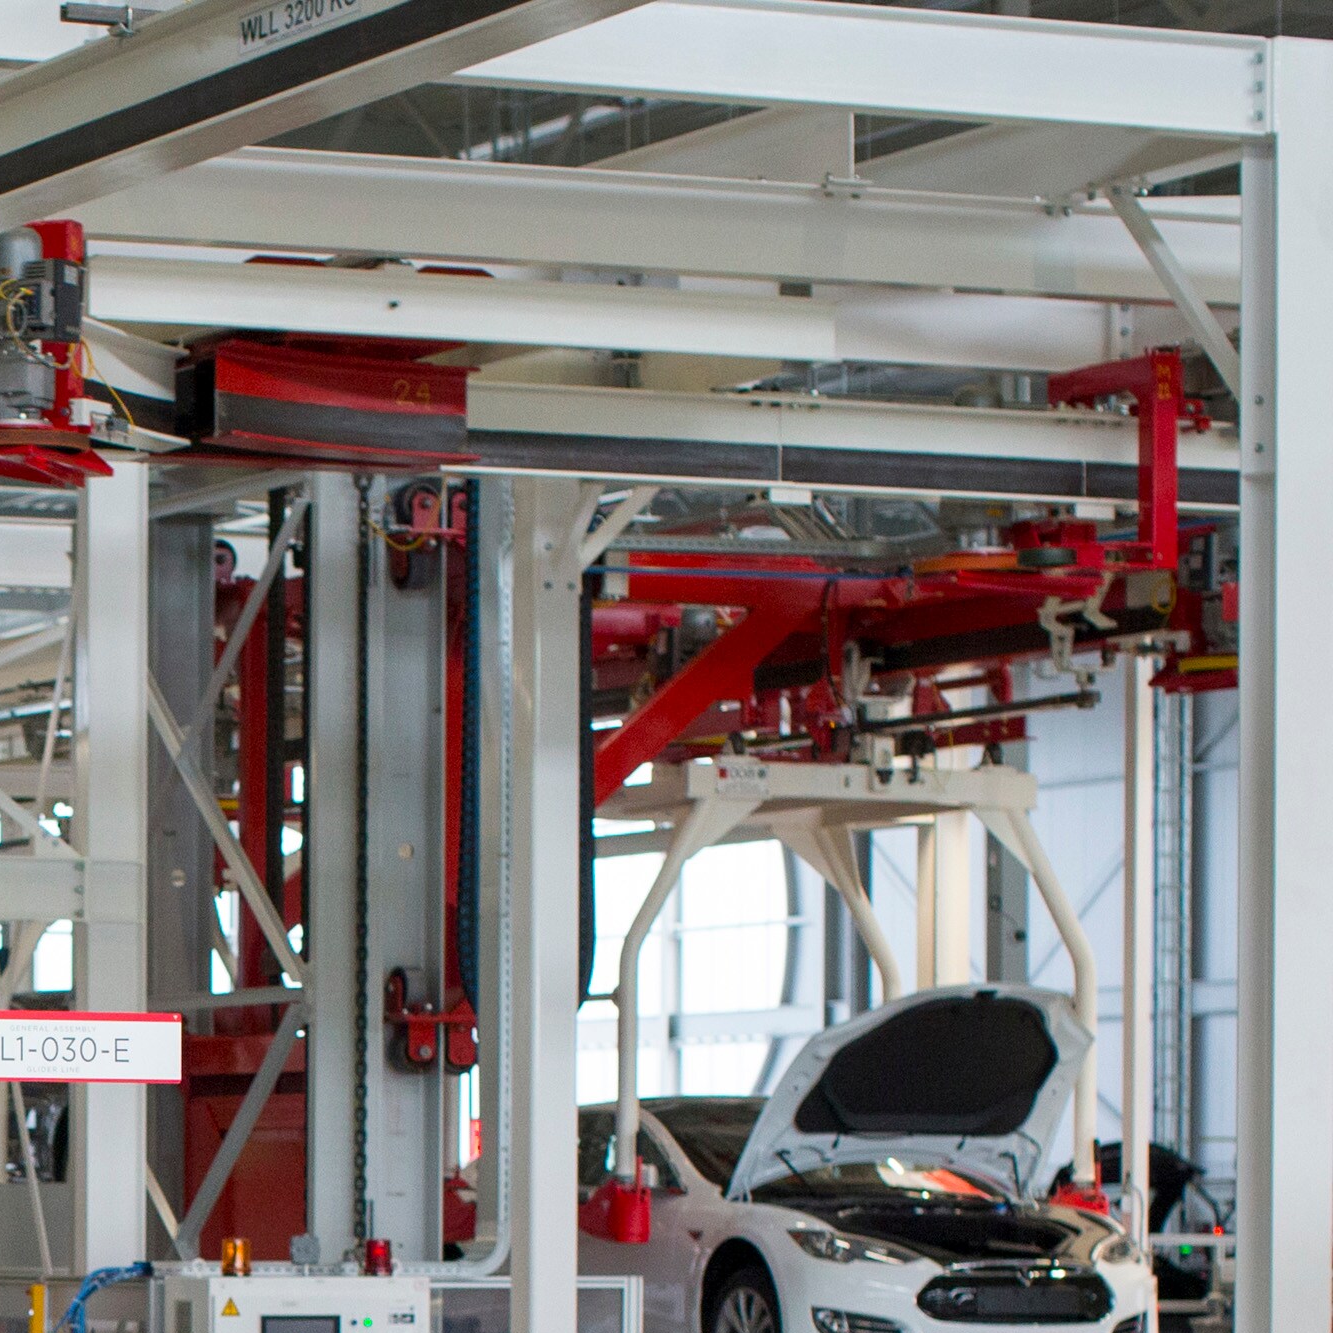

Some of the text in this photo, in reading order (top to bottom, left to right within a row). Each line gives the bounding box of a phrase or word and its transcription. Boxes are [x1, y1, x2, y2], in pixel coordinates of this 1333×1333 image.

[241, 11, 279, 45] WLL
[284, 0, 324, 29] 3200
[54, 1025, 97, 1033] ASSEMBLY
